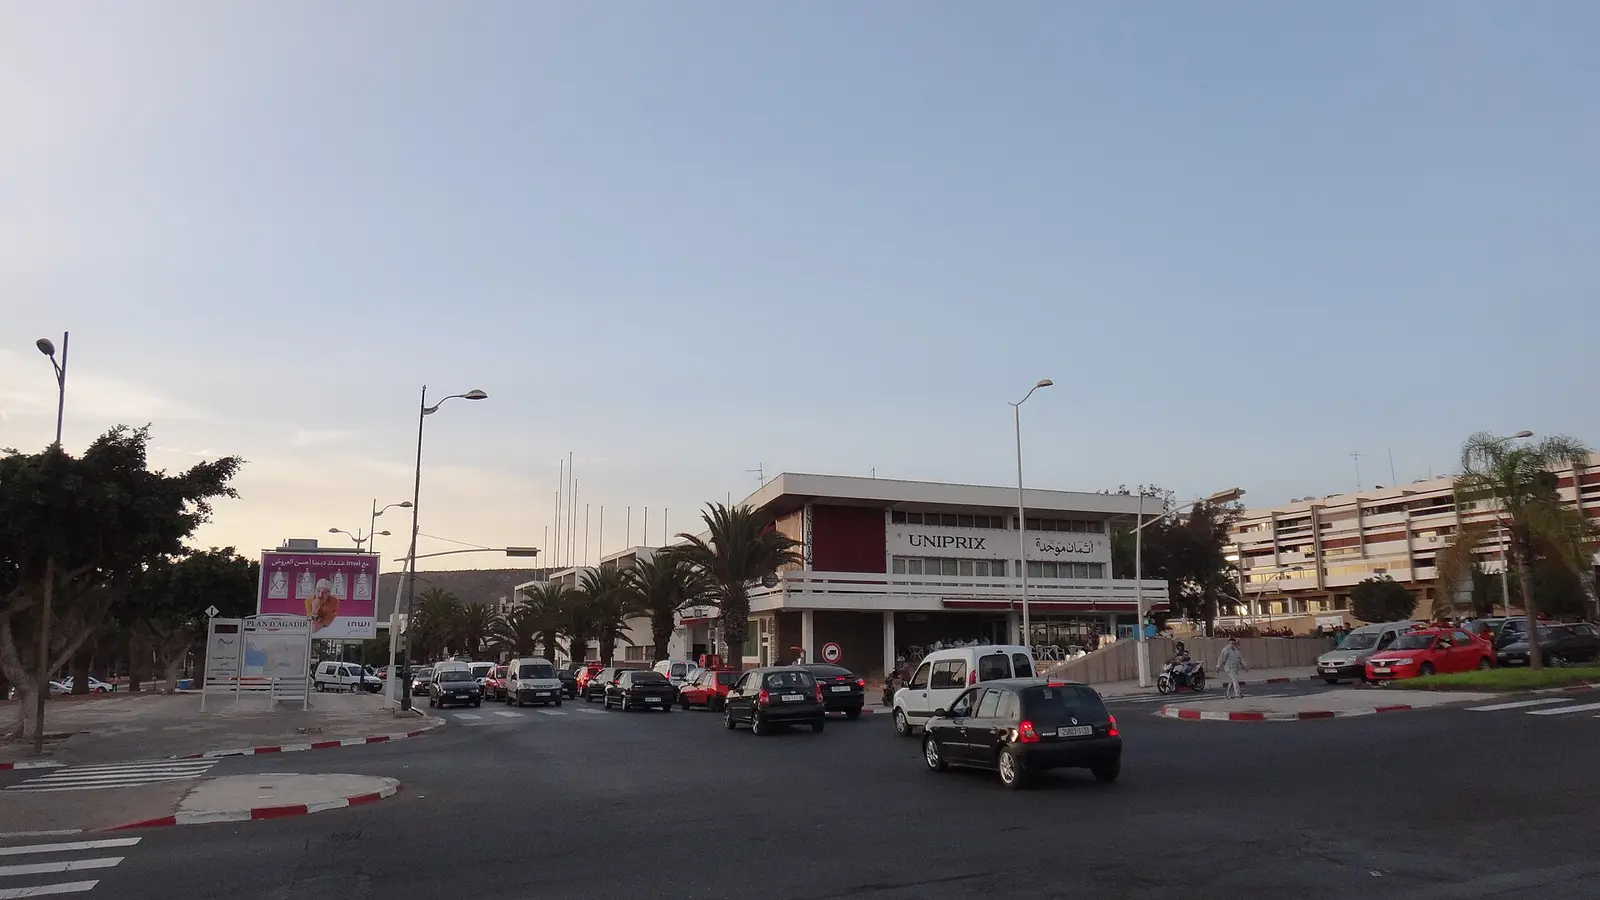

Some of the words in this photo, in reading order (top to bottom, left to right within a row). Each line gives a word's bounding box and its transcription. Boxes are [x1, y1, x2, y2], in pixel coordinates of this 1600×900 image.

[908, 534, 986, 550] UNIPRIX
[271, 558, 294, 567] العروض
[346, 559, 361, 567] inwi
[270, 579, 287, 590] X7
[246, 620, 269, 628] PLAN
[269, 620, 308, 629] D'AGADIR
